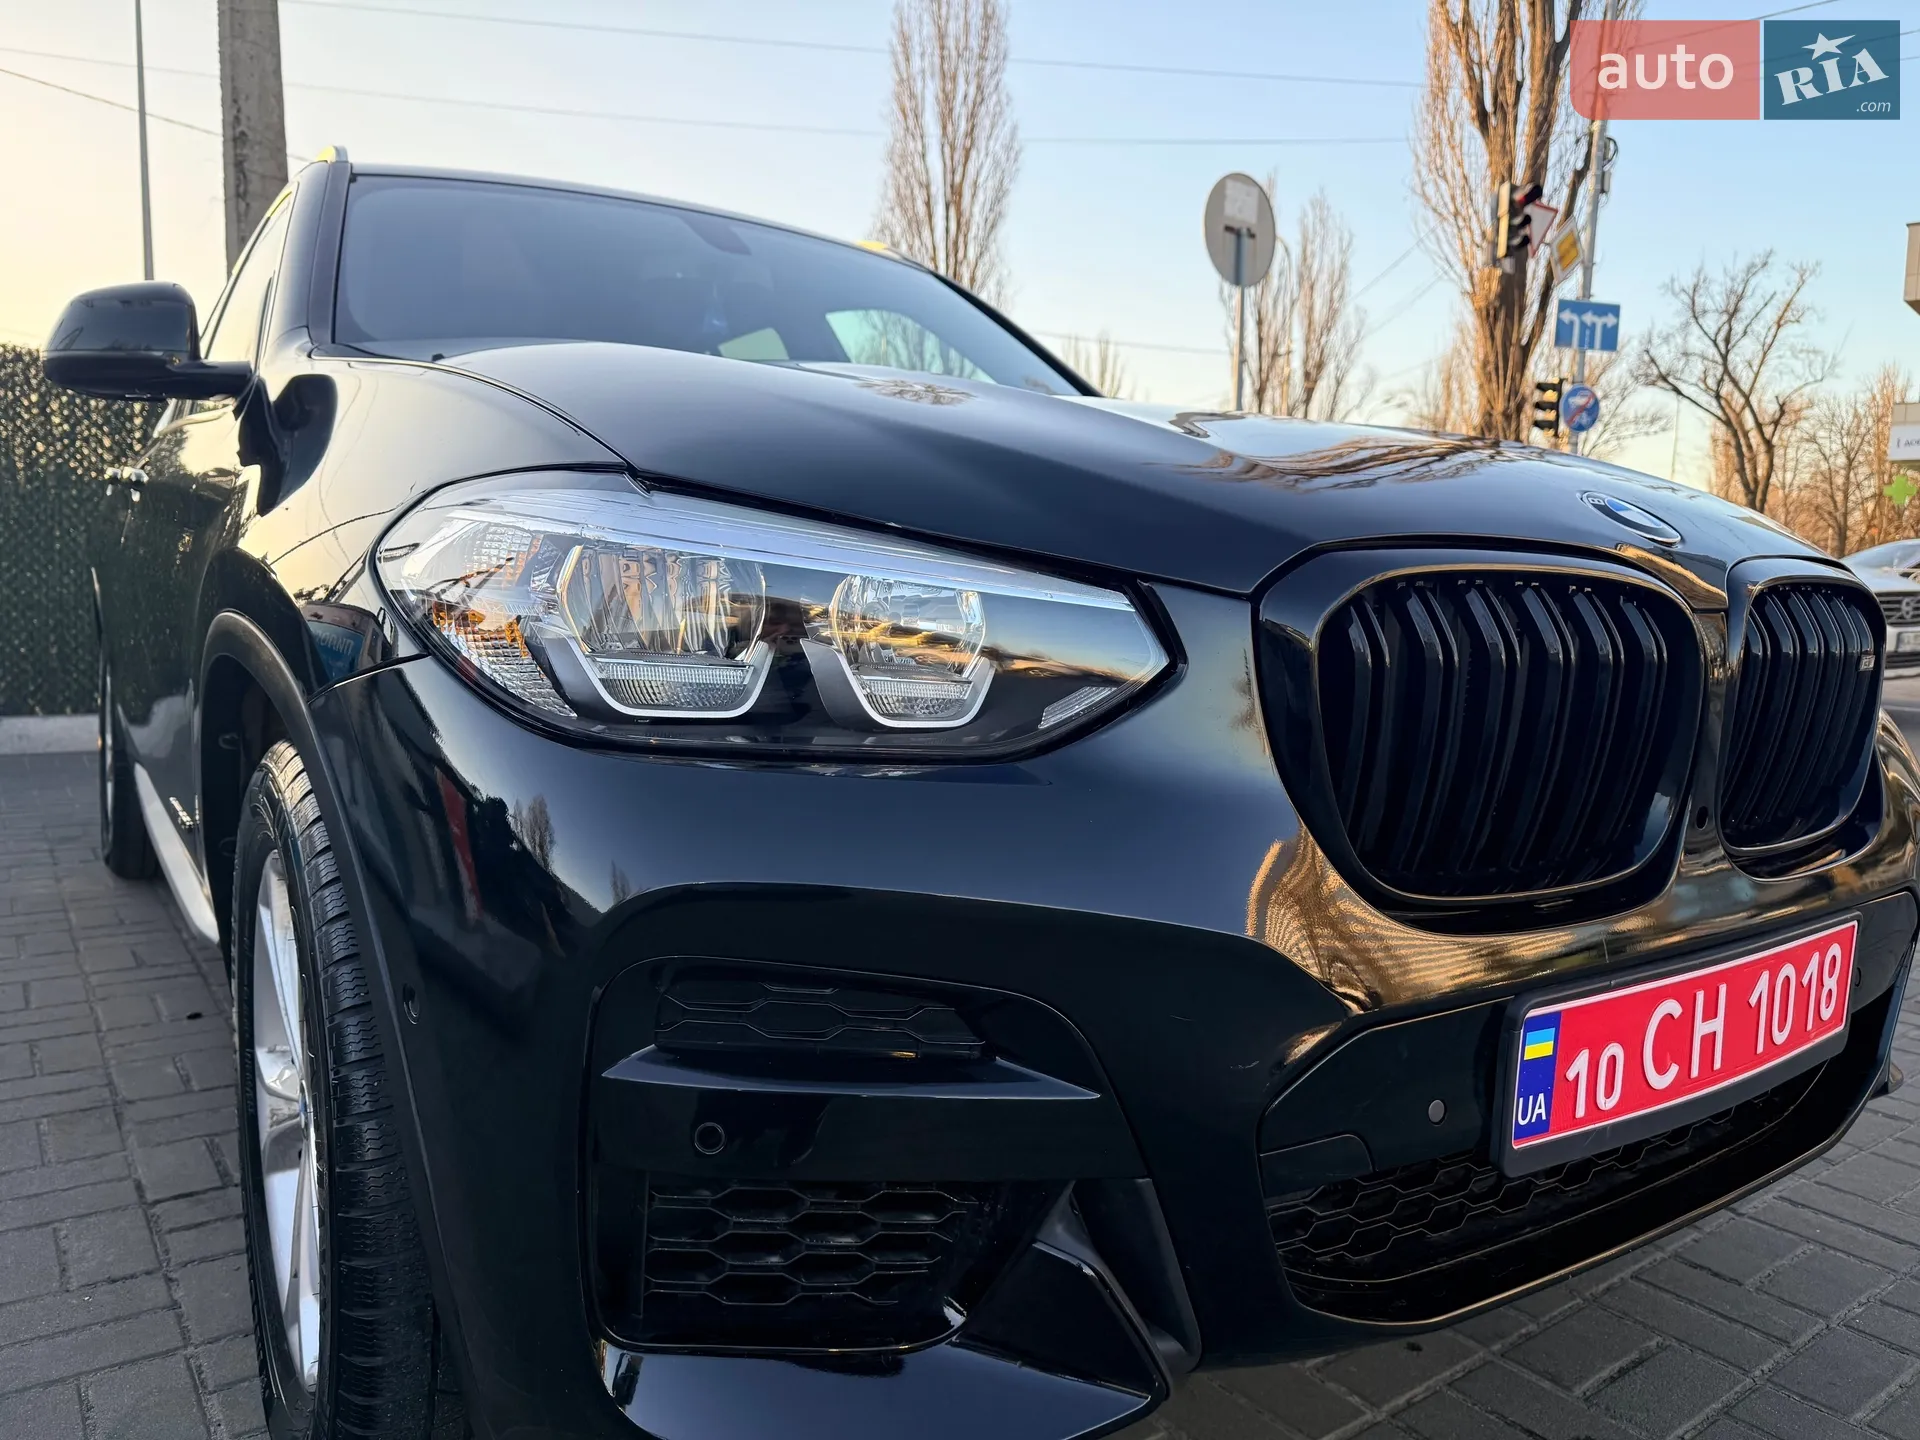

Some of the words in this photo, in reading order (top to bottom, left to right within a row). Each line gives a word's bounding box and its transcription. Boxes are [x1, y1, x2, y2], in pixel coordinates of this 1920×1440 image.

[1566, 1042, 1625, 1119] 10
[1643, 983, 1727, 1090] CH
[1749, 943, 1842, 1055] 1018
[1517, 1092, 1547, 1126] UA
